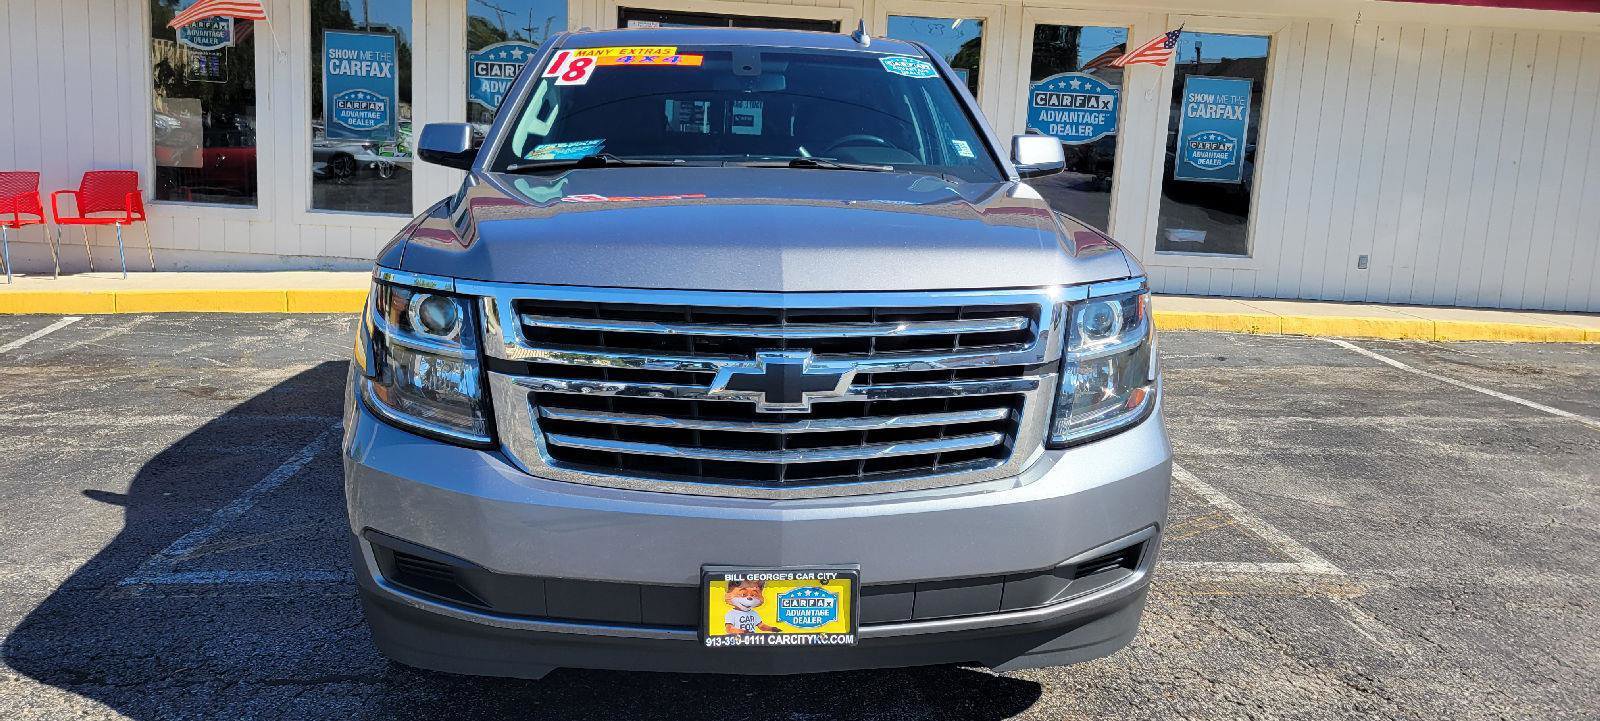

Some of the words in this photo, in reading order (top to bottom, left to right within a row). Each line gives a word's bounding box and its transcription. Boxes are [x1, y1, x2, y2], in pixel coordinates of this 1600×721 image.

[328, 48, 358, 60] SHOW
[360, 50, 374, 61] ME
[374, 51, 392, 62] THE
[576, 49, 613, 57] MANY
[329, 59, 392, 79] CARFAX
[1036, 94, 1111, 110] CARFAX
[1188, 92, 1215, 104] SHOW
[1216, 94, 1230, 104] ME
[1231, 95, 1246, 106] THE
[338, 101, 384, 111] CARFAX
[340, 110, 382, 119] ADVANTAGE
[1187, 102, 1243, 120] CARFAX
[1039, 109, 1105, 125] ADVANTAGE
[348, 118, 375, 126] DEALER
[1049, 123, 1094, 137] DEALER
[1191, 142, 1232, 151] CARFAX
[1192, 150, 1229, 159] ADVANTAGE
[1197, 158, 1222, 166] DEALER
[725, 573, 745, 581] BILL
[747, 573, 794, 581] GEORGE'S
[796, 572, 815, 580] CAR
[817, 572, 838, 580] CITY
[783, 599, 833, 608] CARFAX
[785, 609, 830, 618] ADVANTAGE
[739, 615, 755, 623] CAR
[793, 616, 823, 625] DEALER
[740, 623, 756, 631] FOX
[767, 633, 854, 645] CARCITYKC.COM
